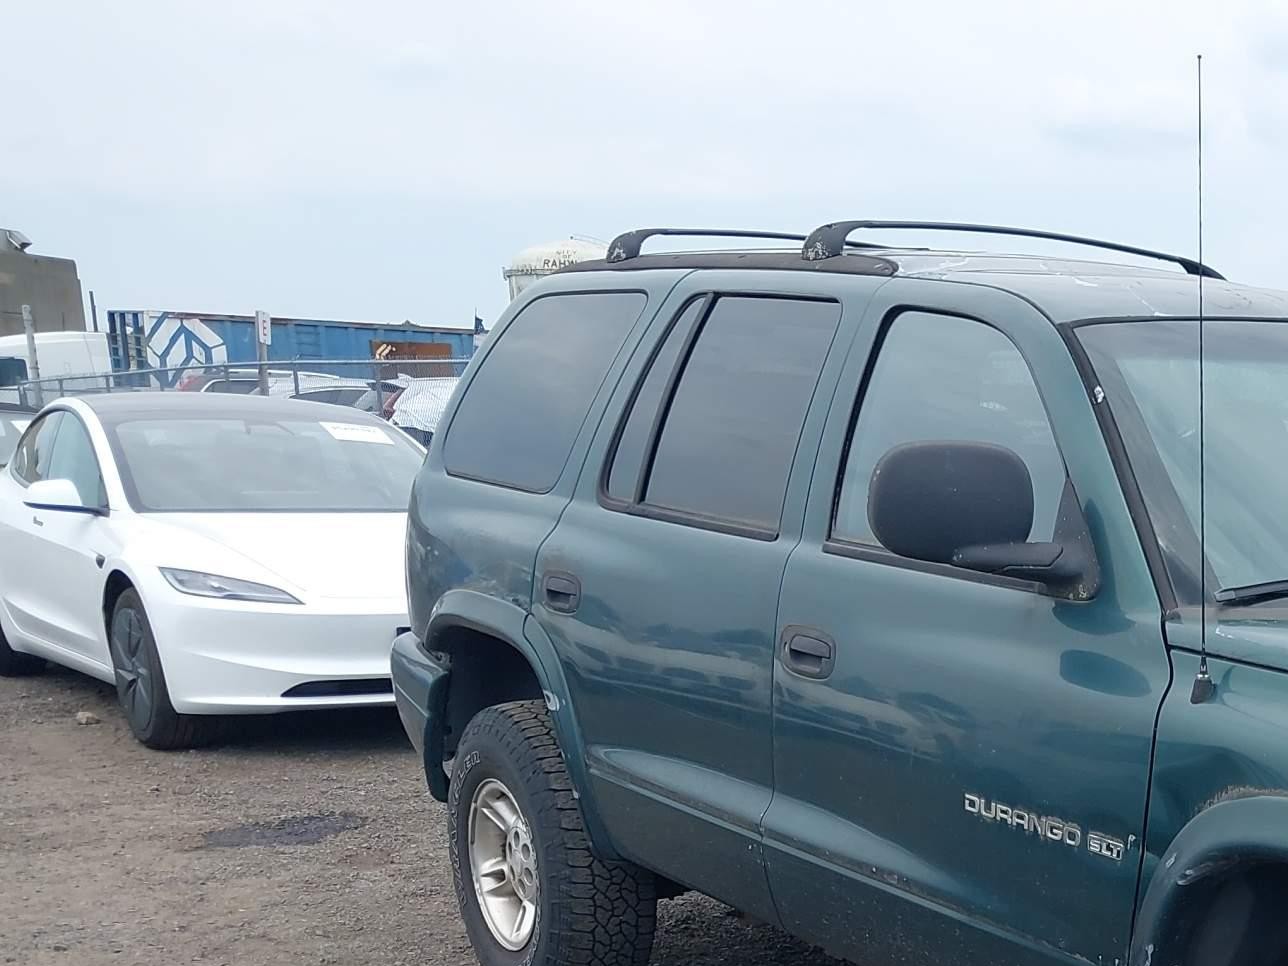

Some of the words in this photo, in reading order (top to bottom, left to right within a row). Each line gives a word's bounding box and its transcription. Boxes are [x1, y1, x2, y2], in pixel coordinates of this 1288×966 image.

[543, 259, 578, 269] RAHW
[964, 793, 1081, 846] DURANGO
[1088, 835, 1124, 860] SLT
